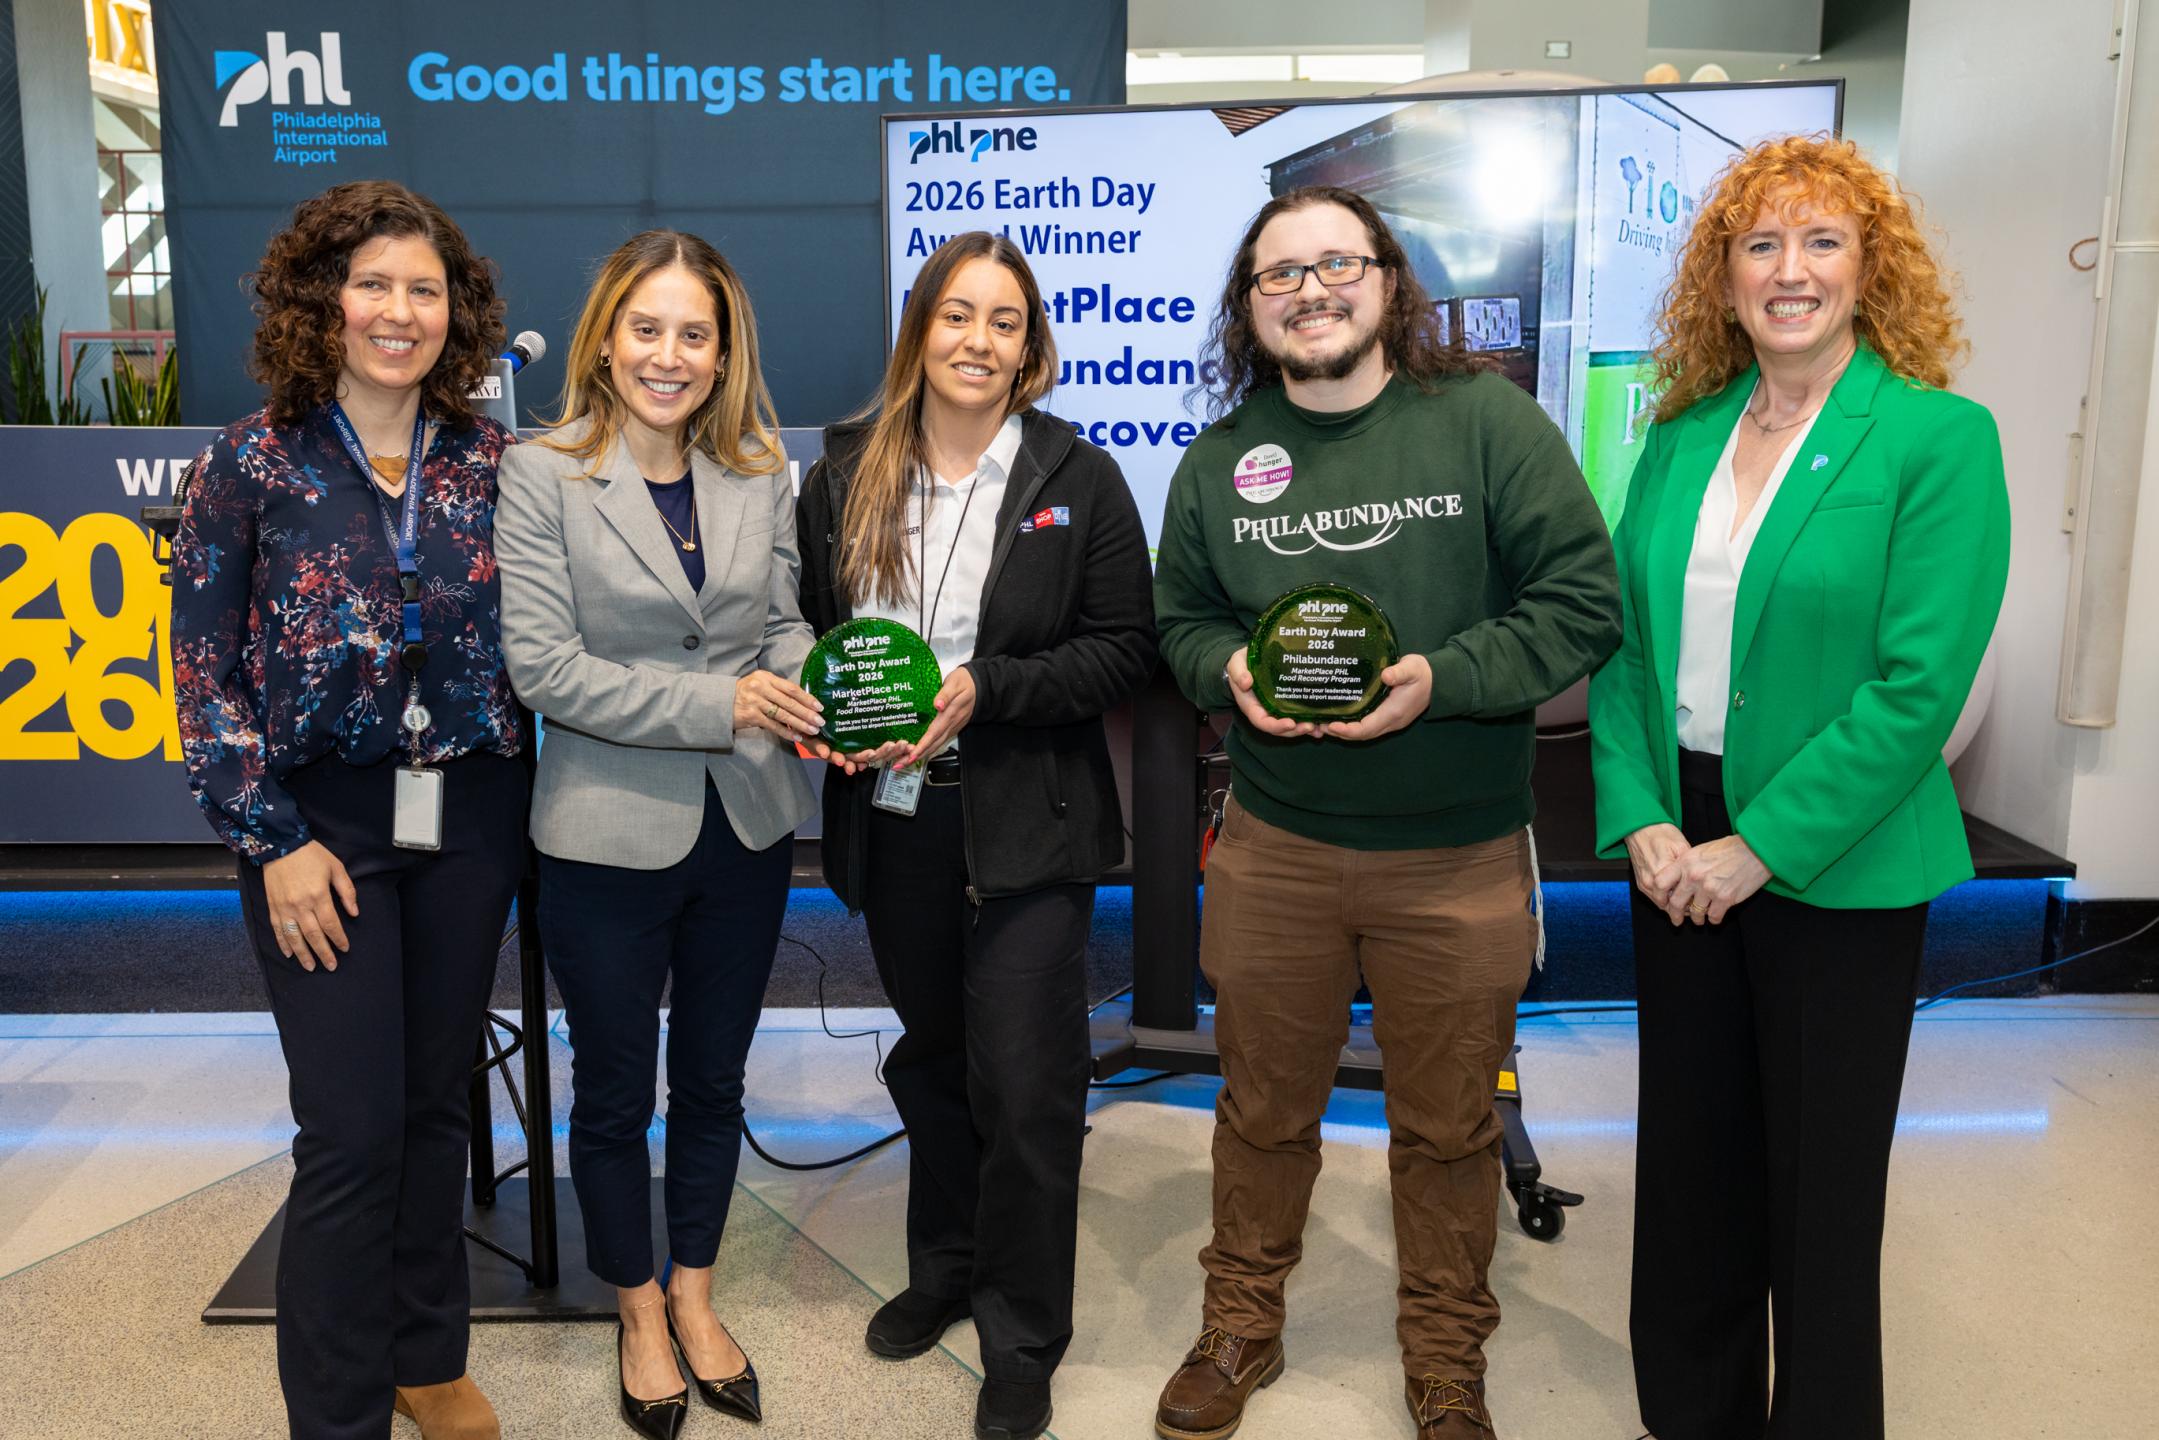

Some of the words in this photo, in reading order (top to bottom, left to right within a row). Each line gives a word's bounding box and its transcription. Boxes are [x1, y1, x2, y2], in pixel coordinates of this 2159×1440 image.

[213, 31, 351, 127] phl
[407, 51, 568, 102] Good
[581, 52, 765, 115] things
[778, 57, 912, 103] start
[928, 53, 1071, 103] here.
[272, 111, 381, 132] Philadelphia
[273, 130, 388, 147] International
[273, 147, 337, 167] Airport
[905, 180, 985, 212] 2026
[994, 176, 1081, 210] Earth
[1092, 176, 1156, 215] Day
[1020, 223, 1142, 255] Winner
[1618, 219, 1663, 257] Driving
[333, 413, 354, 443] AIRPORT
[1258, 457, 1283, 468] hunger
[408, 462, 420, 511] PHILADELPHIA
[1240, 477, 1255, 486] ASK
[1256, 475, 1268, 484] ME
[404, 510, 416, 543] AIRPORT
[1232, 494, 1463, 556] PHILABUNDANCE
[1279, 627, 1307, 637] Earth
[1309, 627, 1330, 638] Day
[1331, 627, 1366, 638] Award
[1307, 640, 1335, 650] 2026
[828, 663, 856, 674] Earth
[857, 660, 877, 671] Day
[879, 656, 911, 668] Award
[1282, 654, 1359, 665] Philabundance
[858, 671, 884, 683] 2026
[1278, 674, 1297, 682] Food
[1297, 674, 1330, 683] Recovery
[1330, 676, 1361, 684] Program
[1291, 667, 1334, 675] MarketPlace
[832, 686, 892, 700] MarketPlace
[893, 682, 914, 692] PHL
[1324, 687, 1352, 695] leadership
[836, 707, 853, 716] Food
[854, 704, 885, 714] Recovery
[885, 701, 914, 711] Program
[847, 697, 887, 708] MarketPlace
[887, 695, 902, 704] PHL
[881, 713, 907, 722] leadership
[835, 725, 861, 733] dedication
[868, 721, 886, 730] airport
